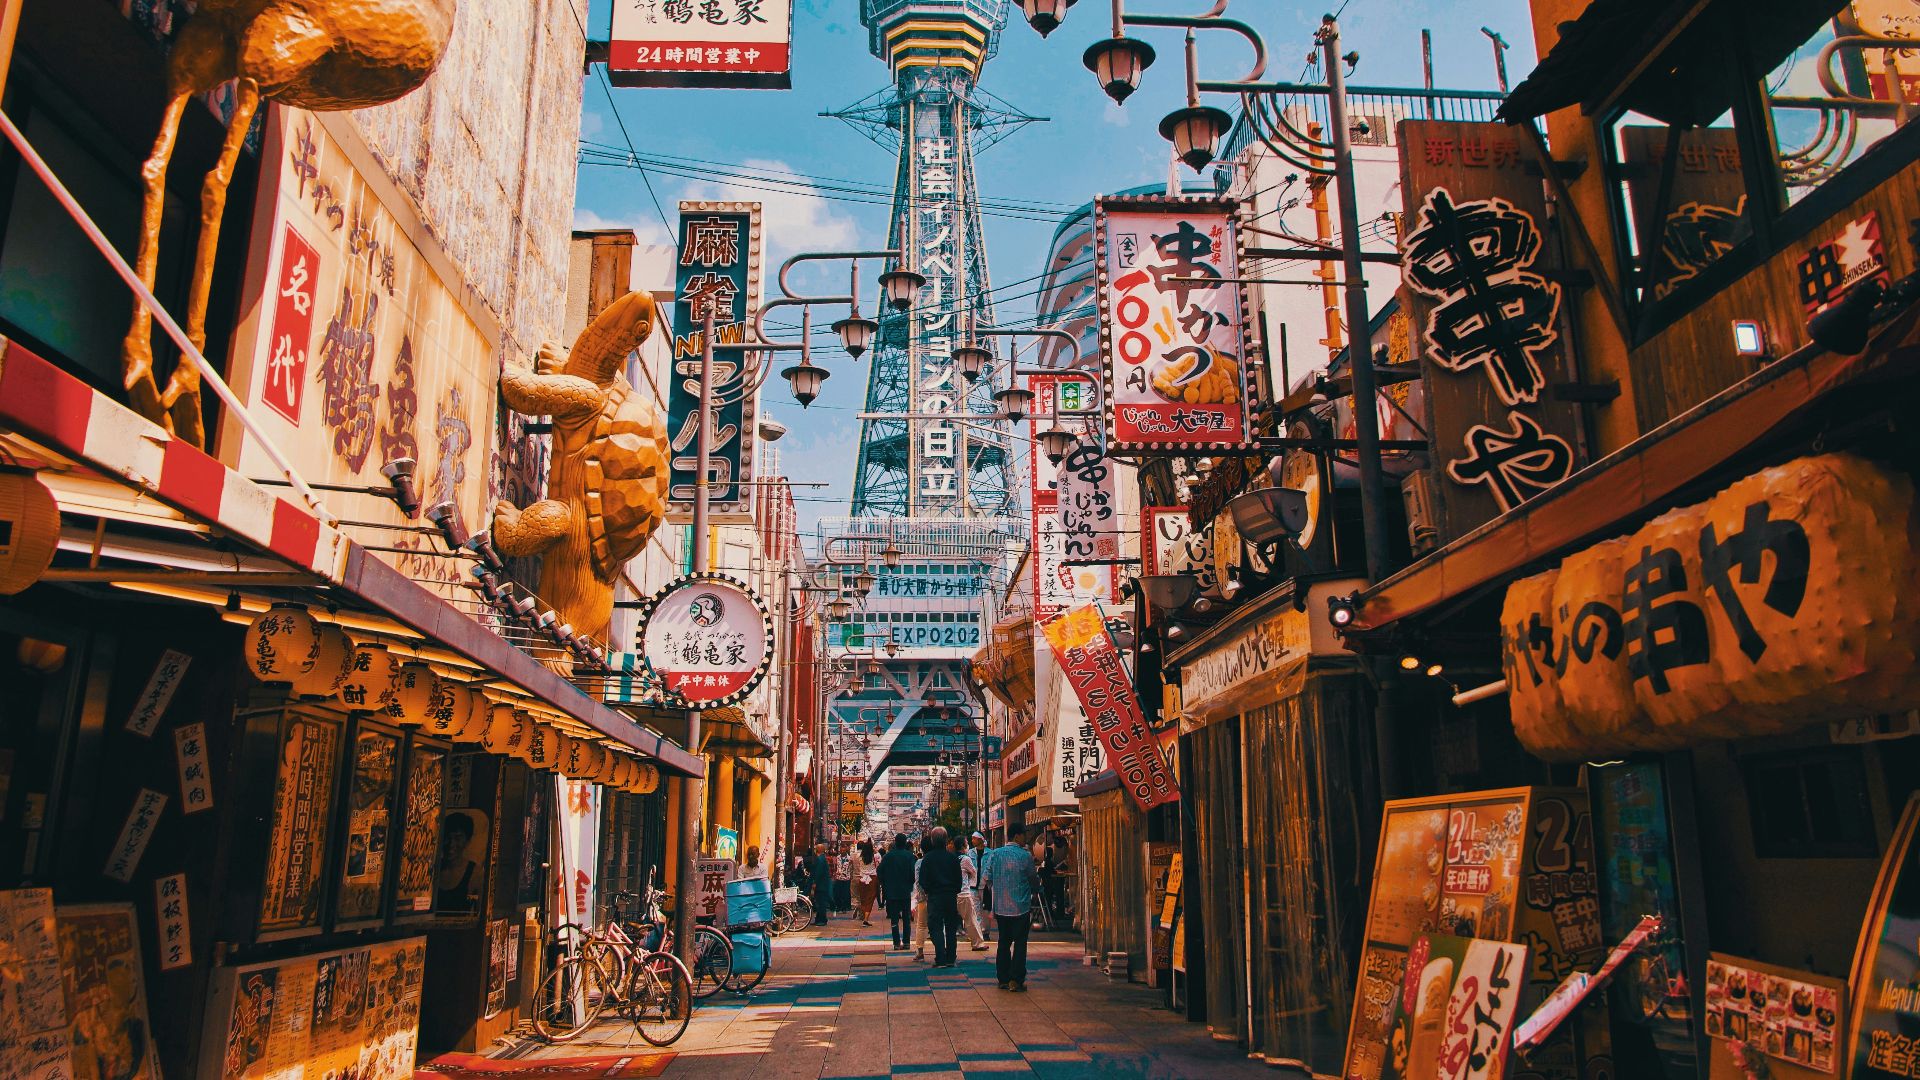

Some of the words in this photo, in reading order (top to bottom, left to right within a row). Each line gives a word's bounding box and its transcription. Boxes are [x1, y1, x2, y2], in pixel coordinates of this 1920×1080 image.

[637, 46, 761, 65] 24時間営業中
[1424, 138, 1520, 169] 新世界
[1119, 236, 1137, 266] 全て
[679, 216, 739, 323] 麻雀
[1842, 254, 1882, 284] SHINSEKA
[920, 138, 958, 497] 社会イノベーションの日立
[1146, 220, 1230, 386] 串かつ
[1400, 187, 1574, 514] 串や
[671, 361, 738, 500] マルコ
[682, 640, 748, 666] 鶴亀家
[679, 675, 730, 687] 年中無休
